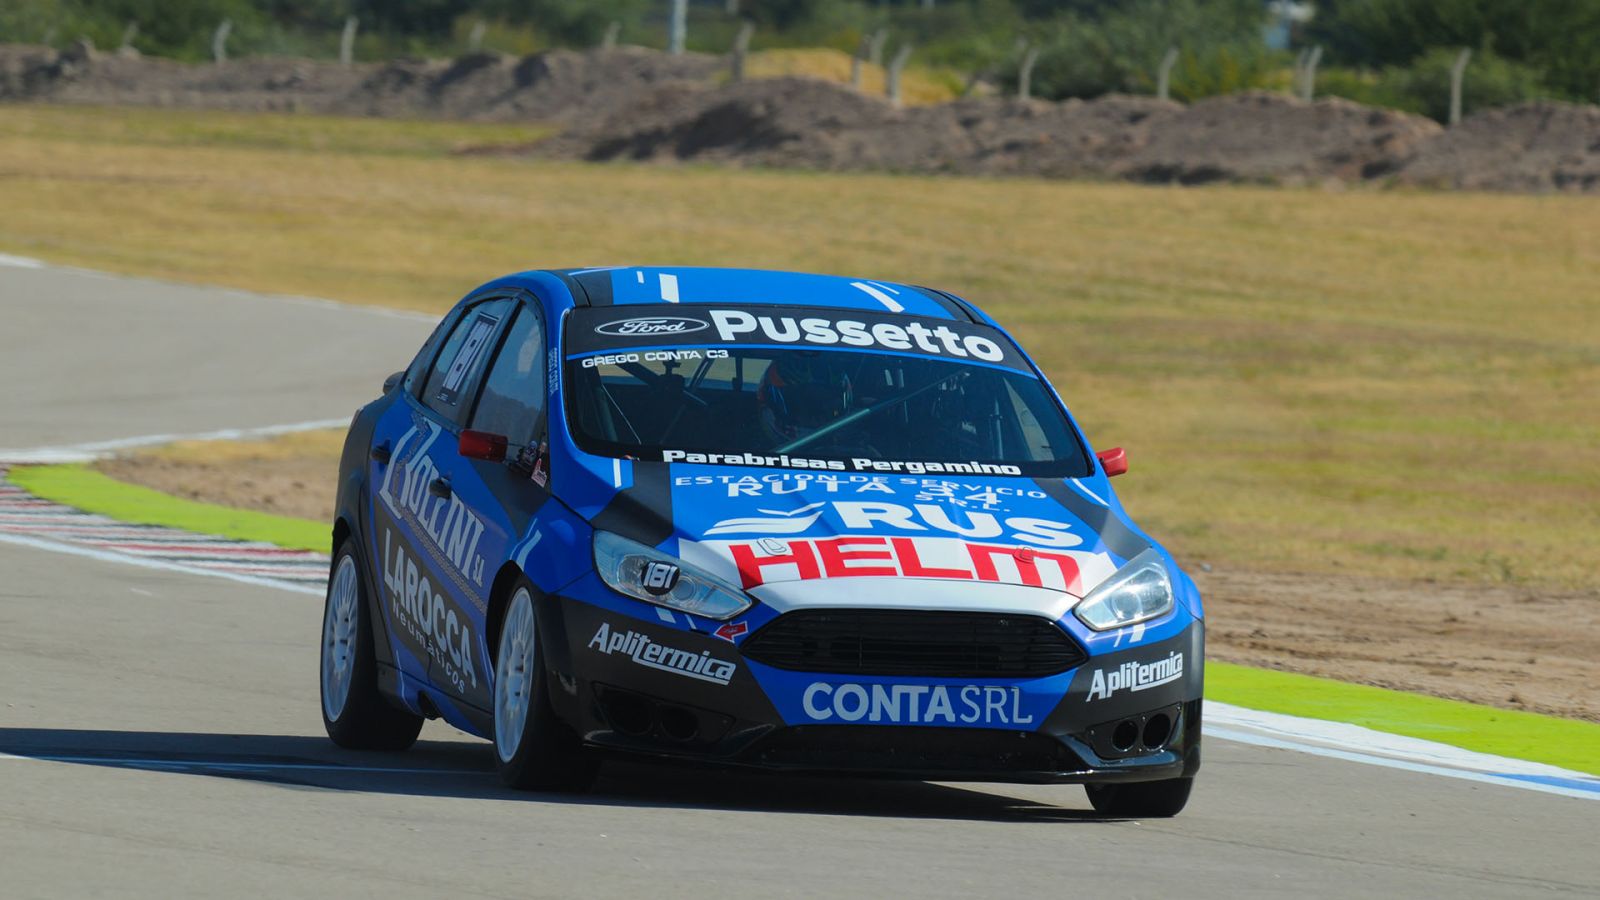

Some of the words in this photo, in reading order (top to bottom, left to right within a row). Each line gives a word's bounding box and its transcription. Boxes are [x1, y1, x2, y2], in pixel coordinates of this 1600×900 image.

[618, 319, 686, 334] Ford
[709, 310, 1004, 363] Pussetto
[582, 354, 639, 368] GREGO
[644, 350, 702, 361] CONTA
[706, 350, 729, 359] C3
[662, 449, 846, 470] Parabrisas
[852, 457, 1021, 477] Pergamino
[675, 473, 837, 486] ESTACION
[849, 475, 889, 484] DE
[900, 478, 1048, 499] SERVICIO
[728, 479, 896, 497] RUTA
[831, 500, 1084, 547] RUS
[643, 562, 678, 589] 181
[384, 527, 477, 689] LAROCCA
[588, 622, 737, 686] Aplitermica
[1086, 651, 1184, 702] Aplitermica
[802, 682, 955, 723] CONTA
[959, 686, 1033, 724] SRL
